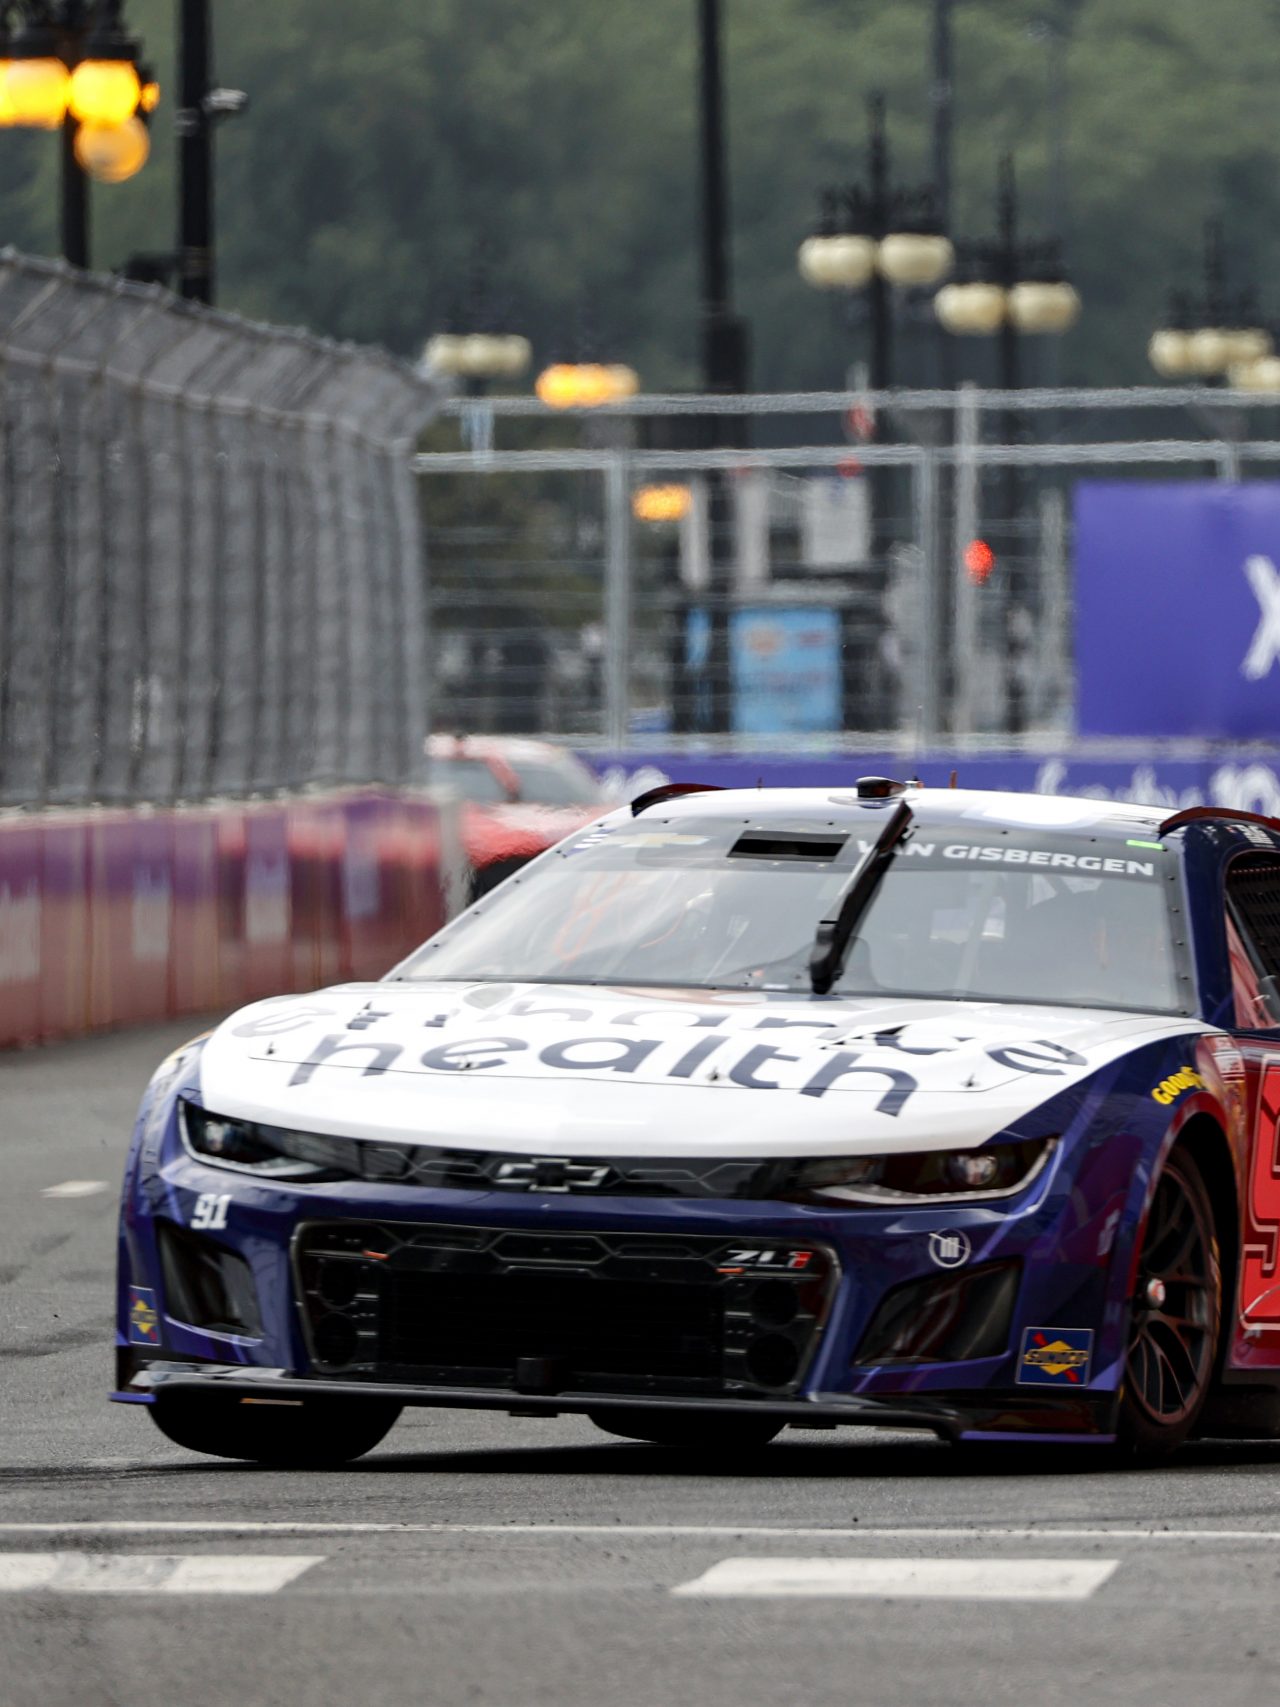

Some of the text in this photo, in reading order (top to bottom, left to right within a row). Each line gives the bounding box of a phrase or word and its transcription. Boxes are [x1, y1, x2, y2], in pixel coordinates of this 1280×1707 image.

[943, 844, 1153, 876] GISBERGEN
[287, 1034, 919, 1117] health
[190, 1194, 233, 1230] 91
